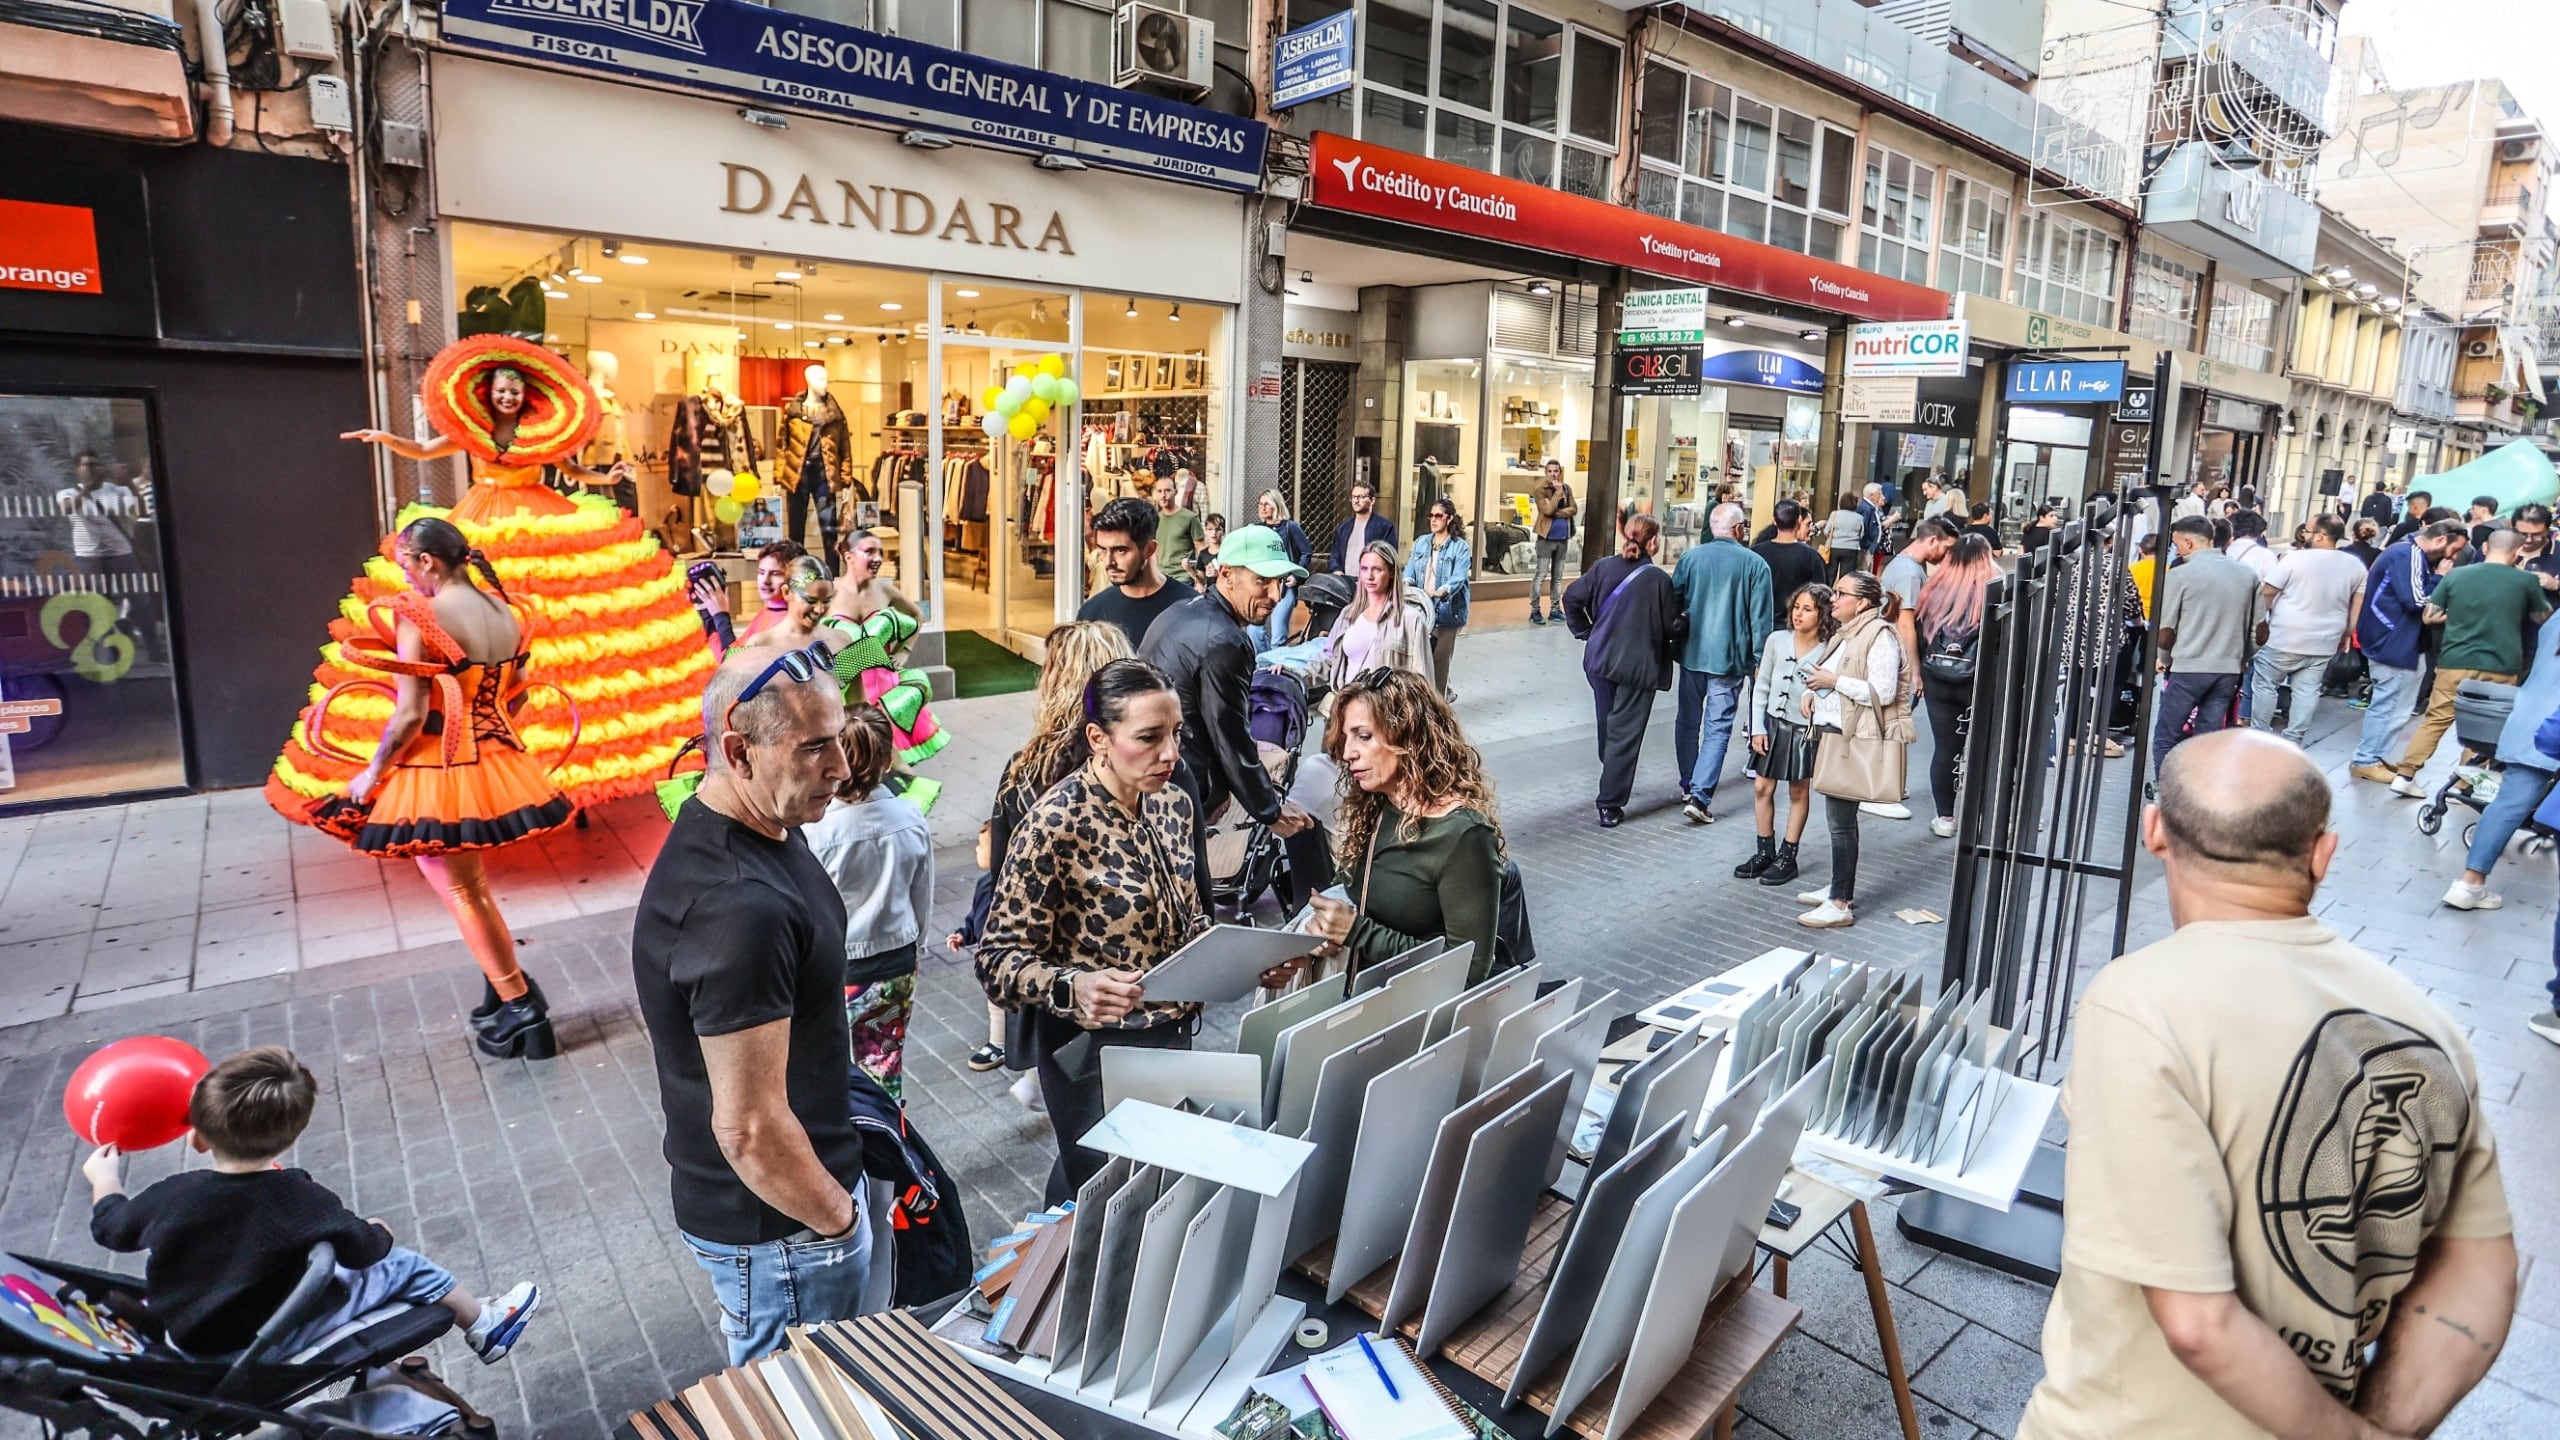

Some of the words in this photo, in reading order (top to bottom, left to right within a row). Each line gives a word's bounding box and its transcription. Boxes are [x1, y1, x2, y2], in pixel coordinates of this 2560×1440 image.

[506, 0, 693, 41] ERELDA
[532, 34, 619, 62] FISCAL
[1281, 22, 1343, 62] ASERELDA
[1279, 72, 1308, 89] CONTABLE
[1316, 61, 1343, 77] JURIDICA
[1283, 65, 1303, 77] FISCAL
[1311, 53, 1338, 68] LABORAL
[755, 25, 915, 85] ASESORIA
[926, 62, 1052, 114] GENERAL
[1063, 91, 1081, 119] Y
[1087, 98, 1122, 129] DE
[1128, 106, 1247, 154] EMPRESAS
[761, 78, 854, 108] LABORAL
[971, 120, 1057, 147] CONTABLE
[1153, 156, 1217, 178] JURIDICA
[1362, 166, 1431, 202] Crédito
[1434, 187, 1447, 210] y
[1448, 186, 1517, 221] Caución
[719, 161, 1075, 256] DANDARA
[1651, 239, 1682, 260] Crédito
[1683, 250, 1689, 262] y
[1689, 249, 1721, 268] Caución
[1625, 293, 1663, 307] CLINICA
[1665, 292, 1703, 305] DENTAL
[1817, 279, 1841, 296] Crédito
[1845, 286, 1869, 302] Caución
[1286, 328, 1314, 344] año
[1640, 332, 1656, 343] 965
[1657, 332, 1669, 342] 38
[1670, 331, 1682, 341] 23
[1683, 331, 1695, 340] 72
[1854, 333, 1959, 356] nutriCOR
[1628, 354, 1691, 378] GIL&GIL
[1758, 353, 1783, 375] LLAR
[2016, 369, 2072, 392] LLAR
